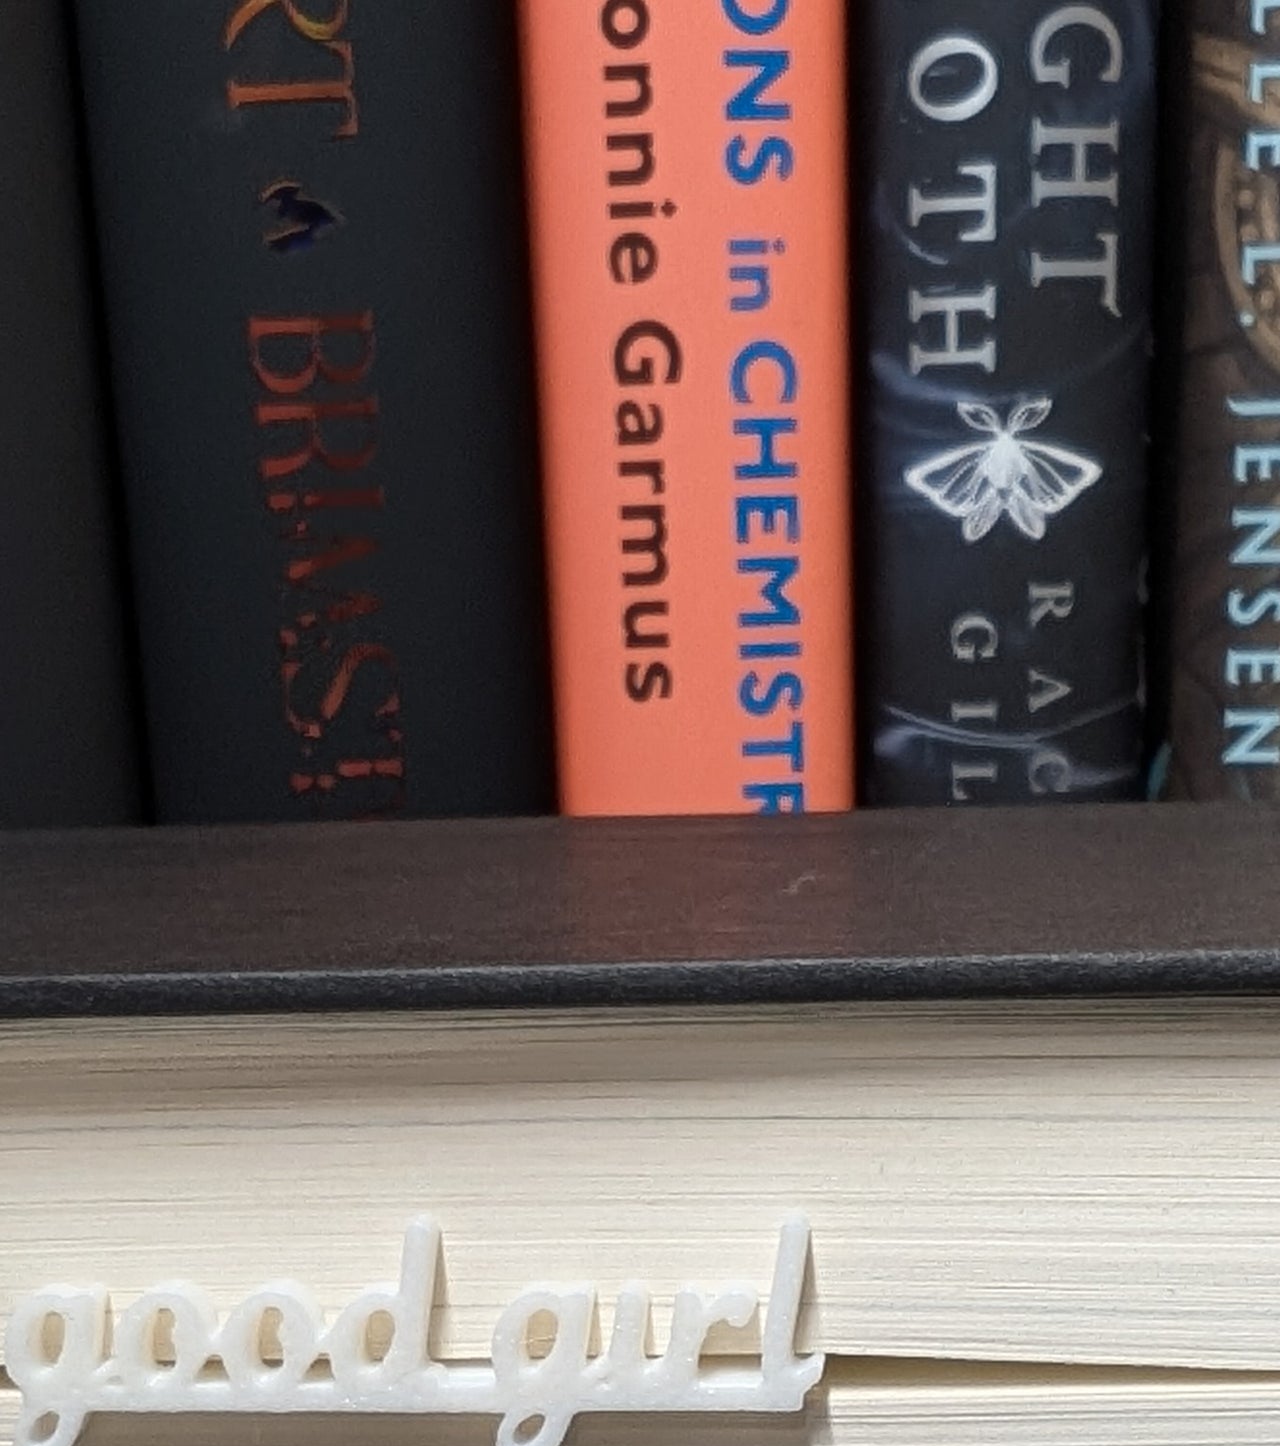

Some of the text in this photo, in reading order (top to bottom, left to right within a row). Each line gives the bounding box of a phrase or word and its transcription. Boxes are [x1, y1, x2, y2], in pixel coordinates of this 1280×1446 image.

[727, 237, 786, 312] in
[907, 36, 999, 376] OTH
[1029, 5, 1123, 317] GHT
[600, 0, 683, 704] onnie Garmus
[246, 309, 408, 821] BRIMST
